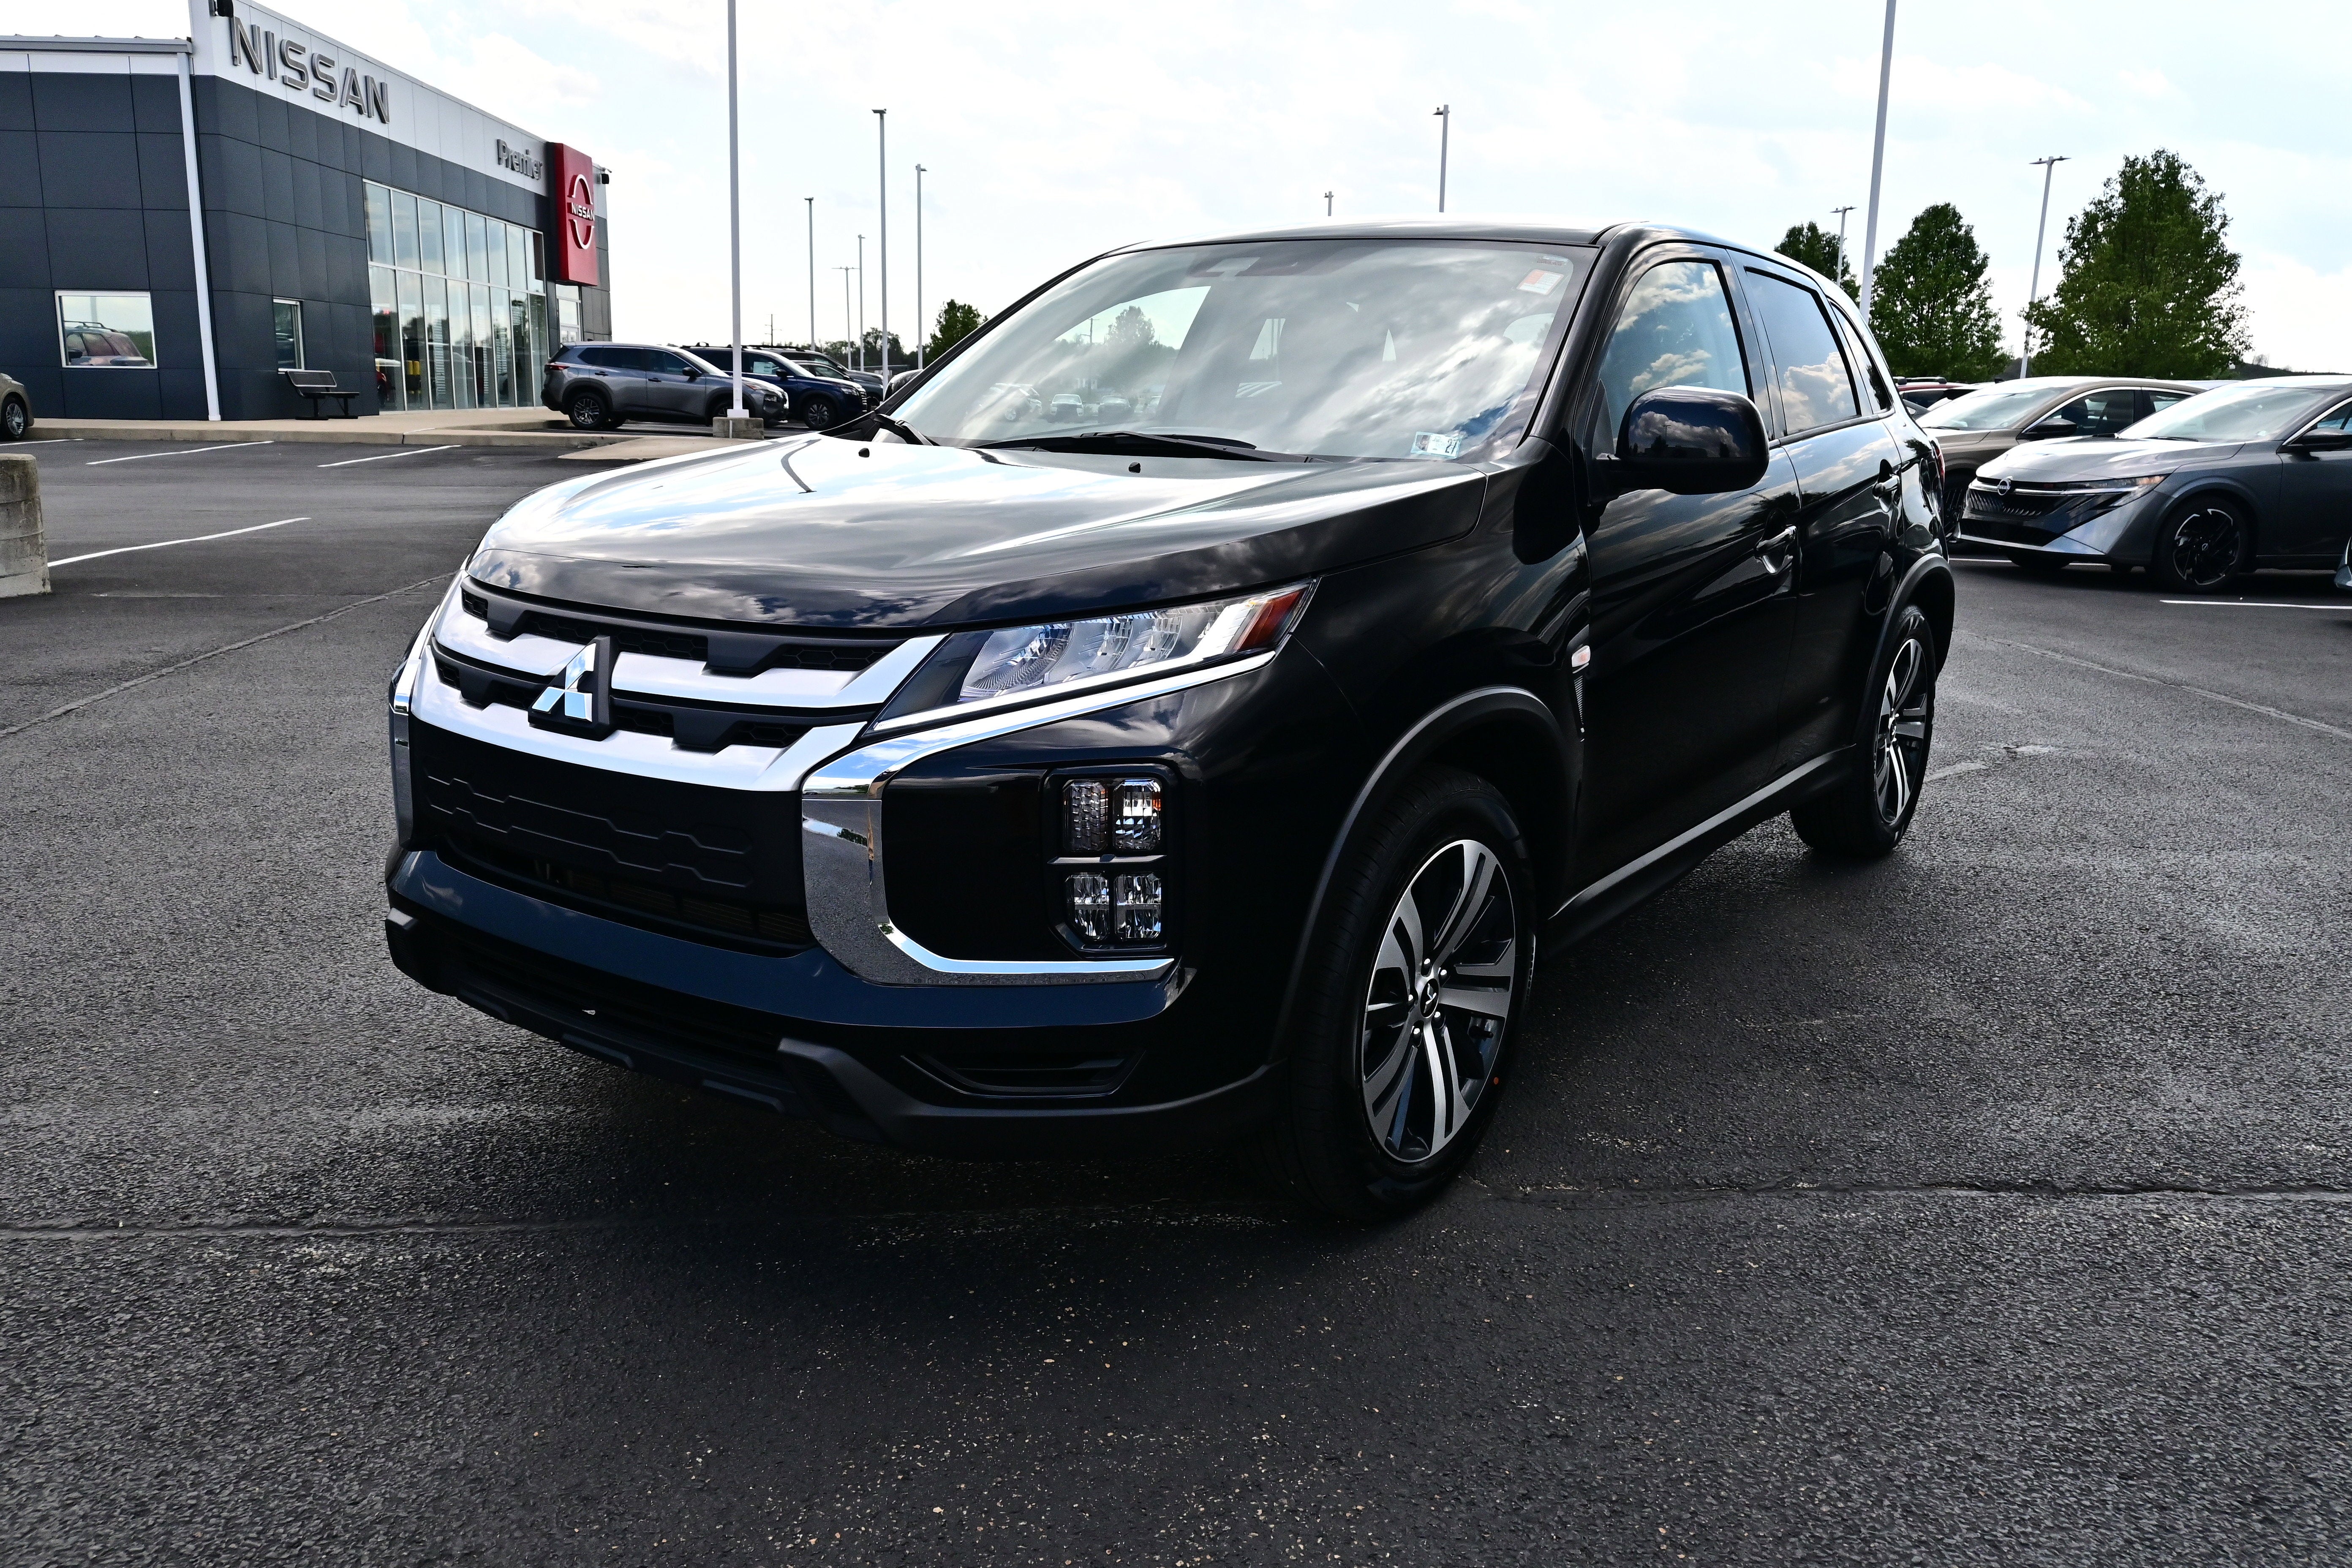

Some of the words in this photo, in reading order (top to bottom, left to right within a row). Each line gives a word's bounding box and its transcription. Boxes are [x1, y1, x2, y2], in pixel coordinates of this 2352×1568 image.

[230, 16, 390, 124] NISSAN
[497, 139, 543, 180] Premier
[571, 202, 595, 221] NISSAN
